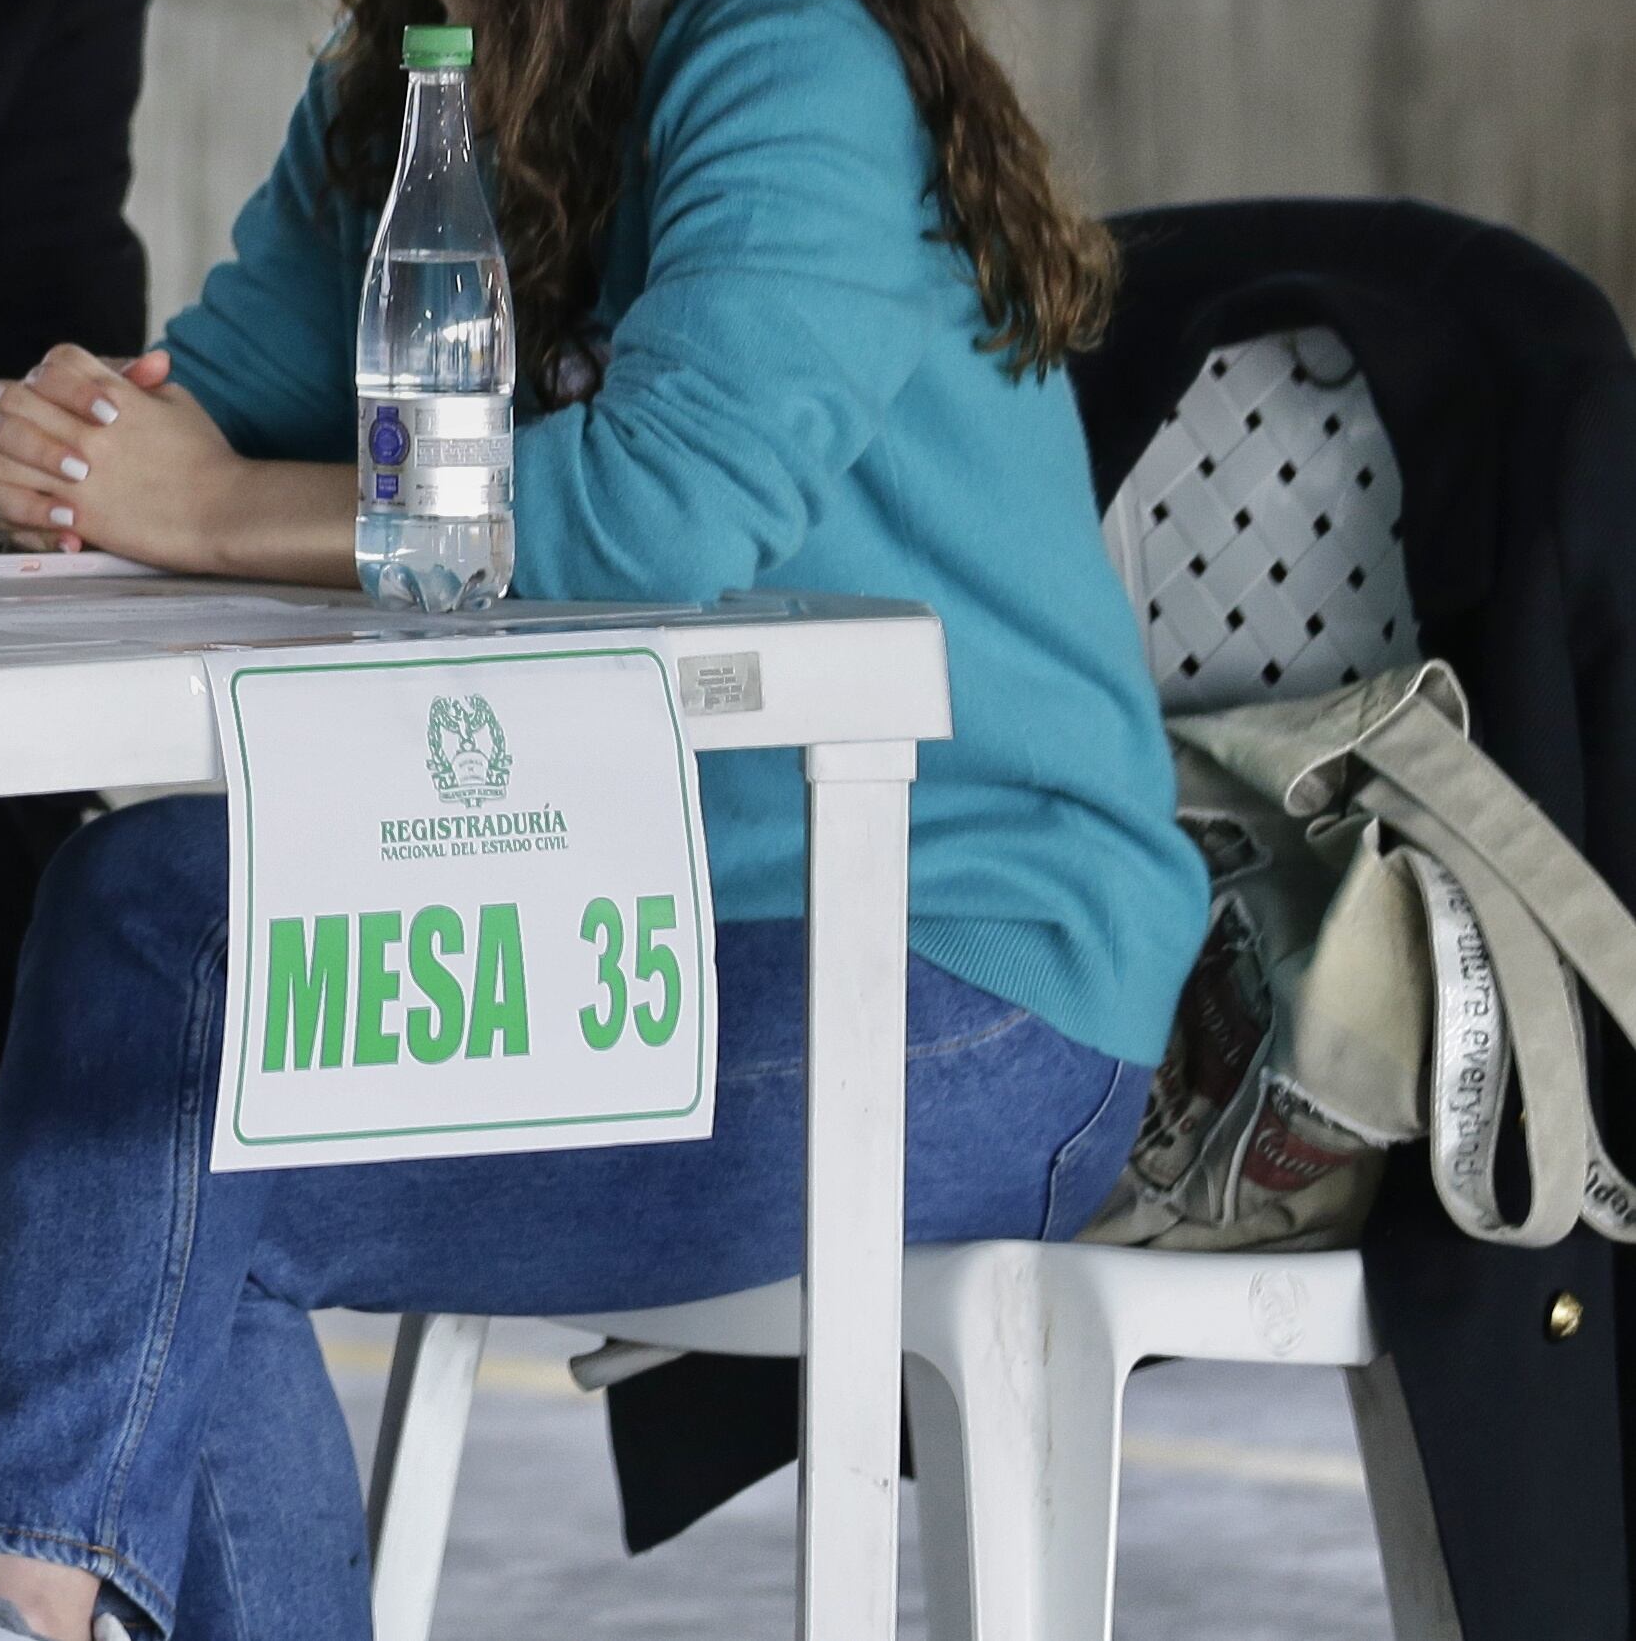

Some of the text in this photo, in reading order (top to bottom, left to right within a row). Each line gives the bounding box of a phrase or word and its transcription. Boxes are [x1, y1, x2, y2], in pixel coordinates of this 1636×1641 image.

[380, 803, 568, 843] REGISTRADURÍA
[381, 836, 569, 861] NACIONAL DEL ESTADO CIVIL
[261, 895, 683, 1074] MESA 35
